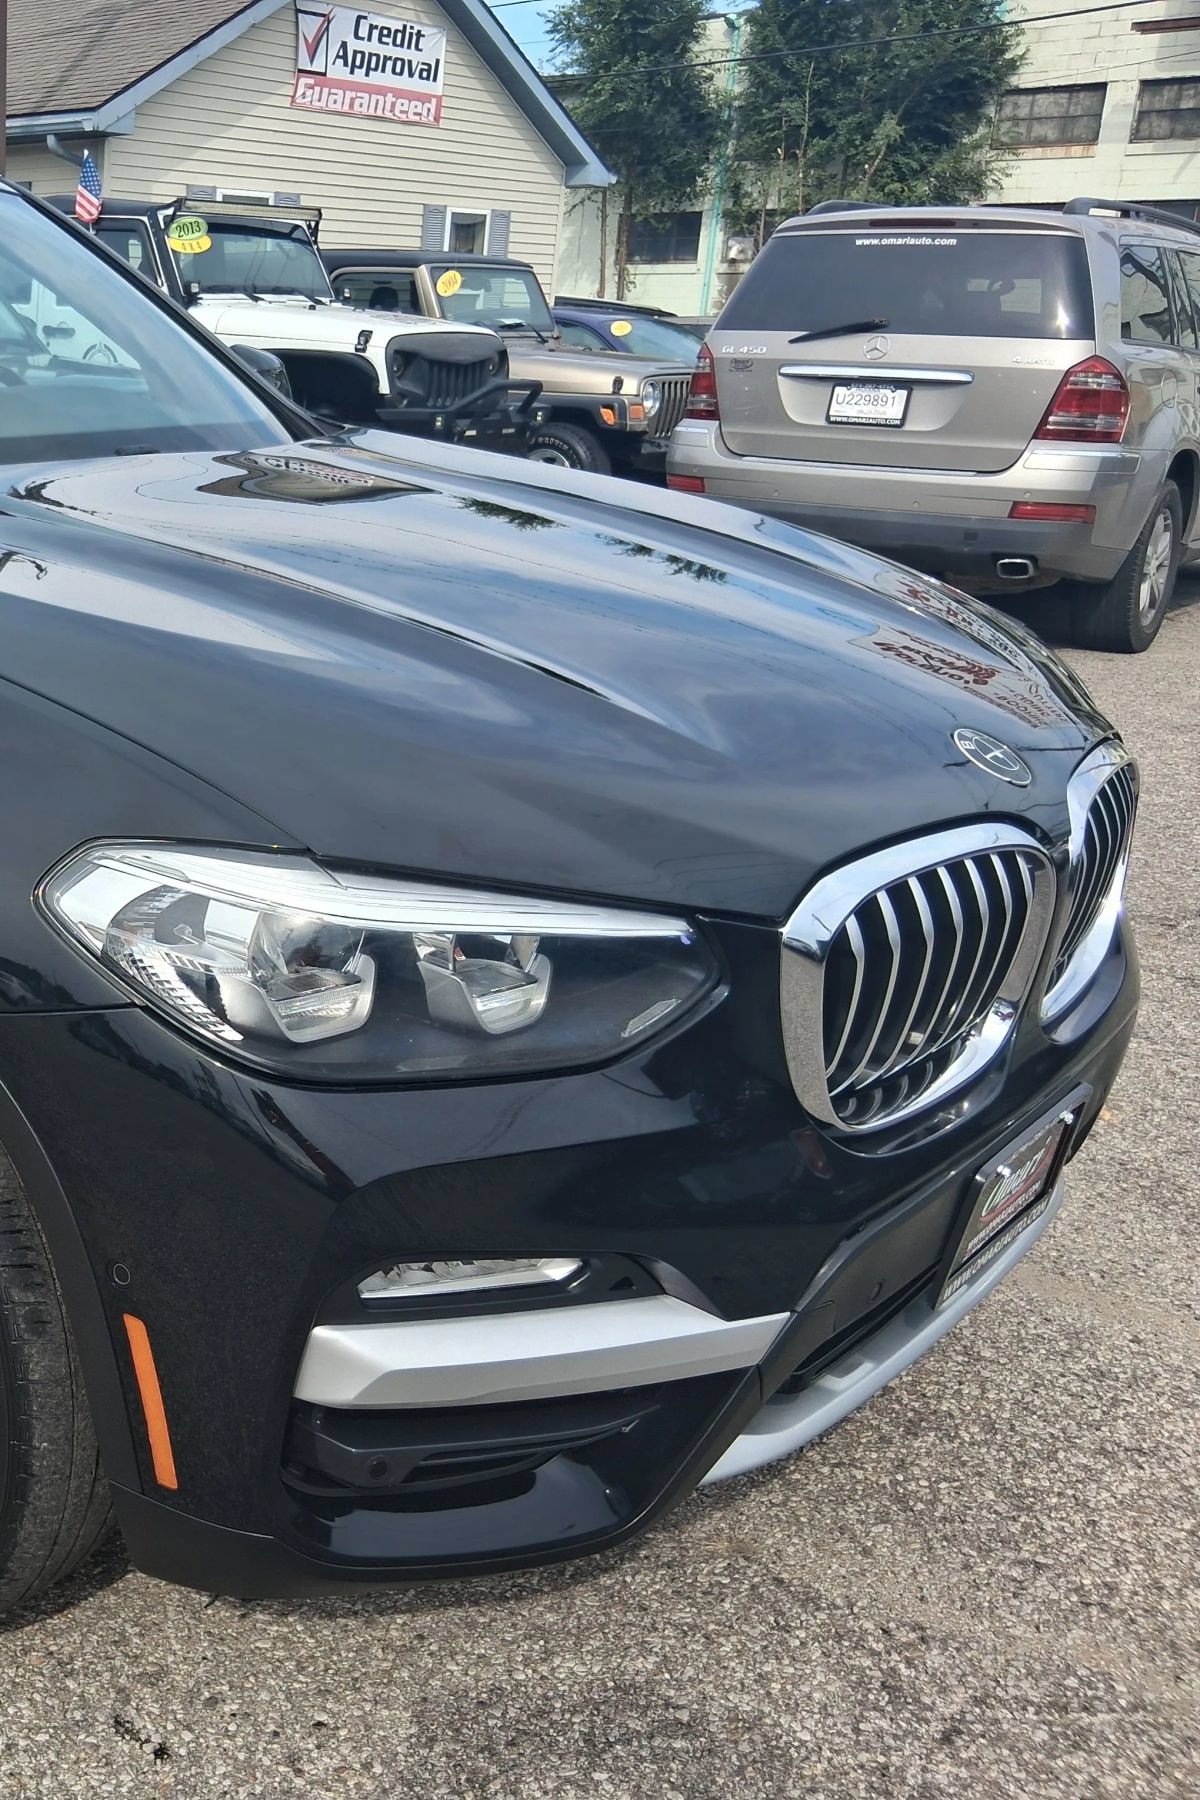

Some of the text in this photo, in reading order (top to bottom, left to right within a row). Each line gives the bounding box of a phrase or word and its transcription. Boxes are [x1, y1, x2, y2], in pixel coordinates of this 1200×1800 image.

[353, 14, 425, 52] Credit
[331, 40, 440, 83] Approval
[295, 78, 437, 122] Guaranteed
[175, 220, 202, 238] 2013
[855, 236, 957, 246] www.omariauto.com
[738, 346, 768, 355] 450
[835, 393, 897, 408] U229891
